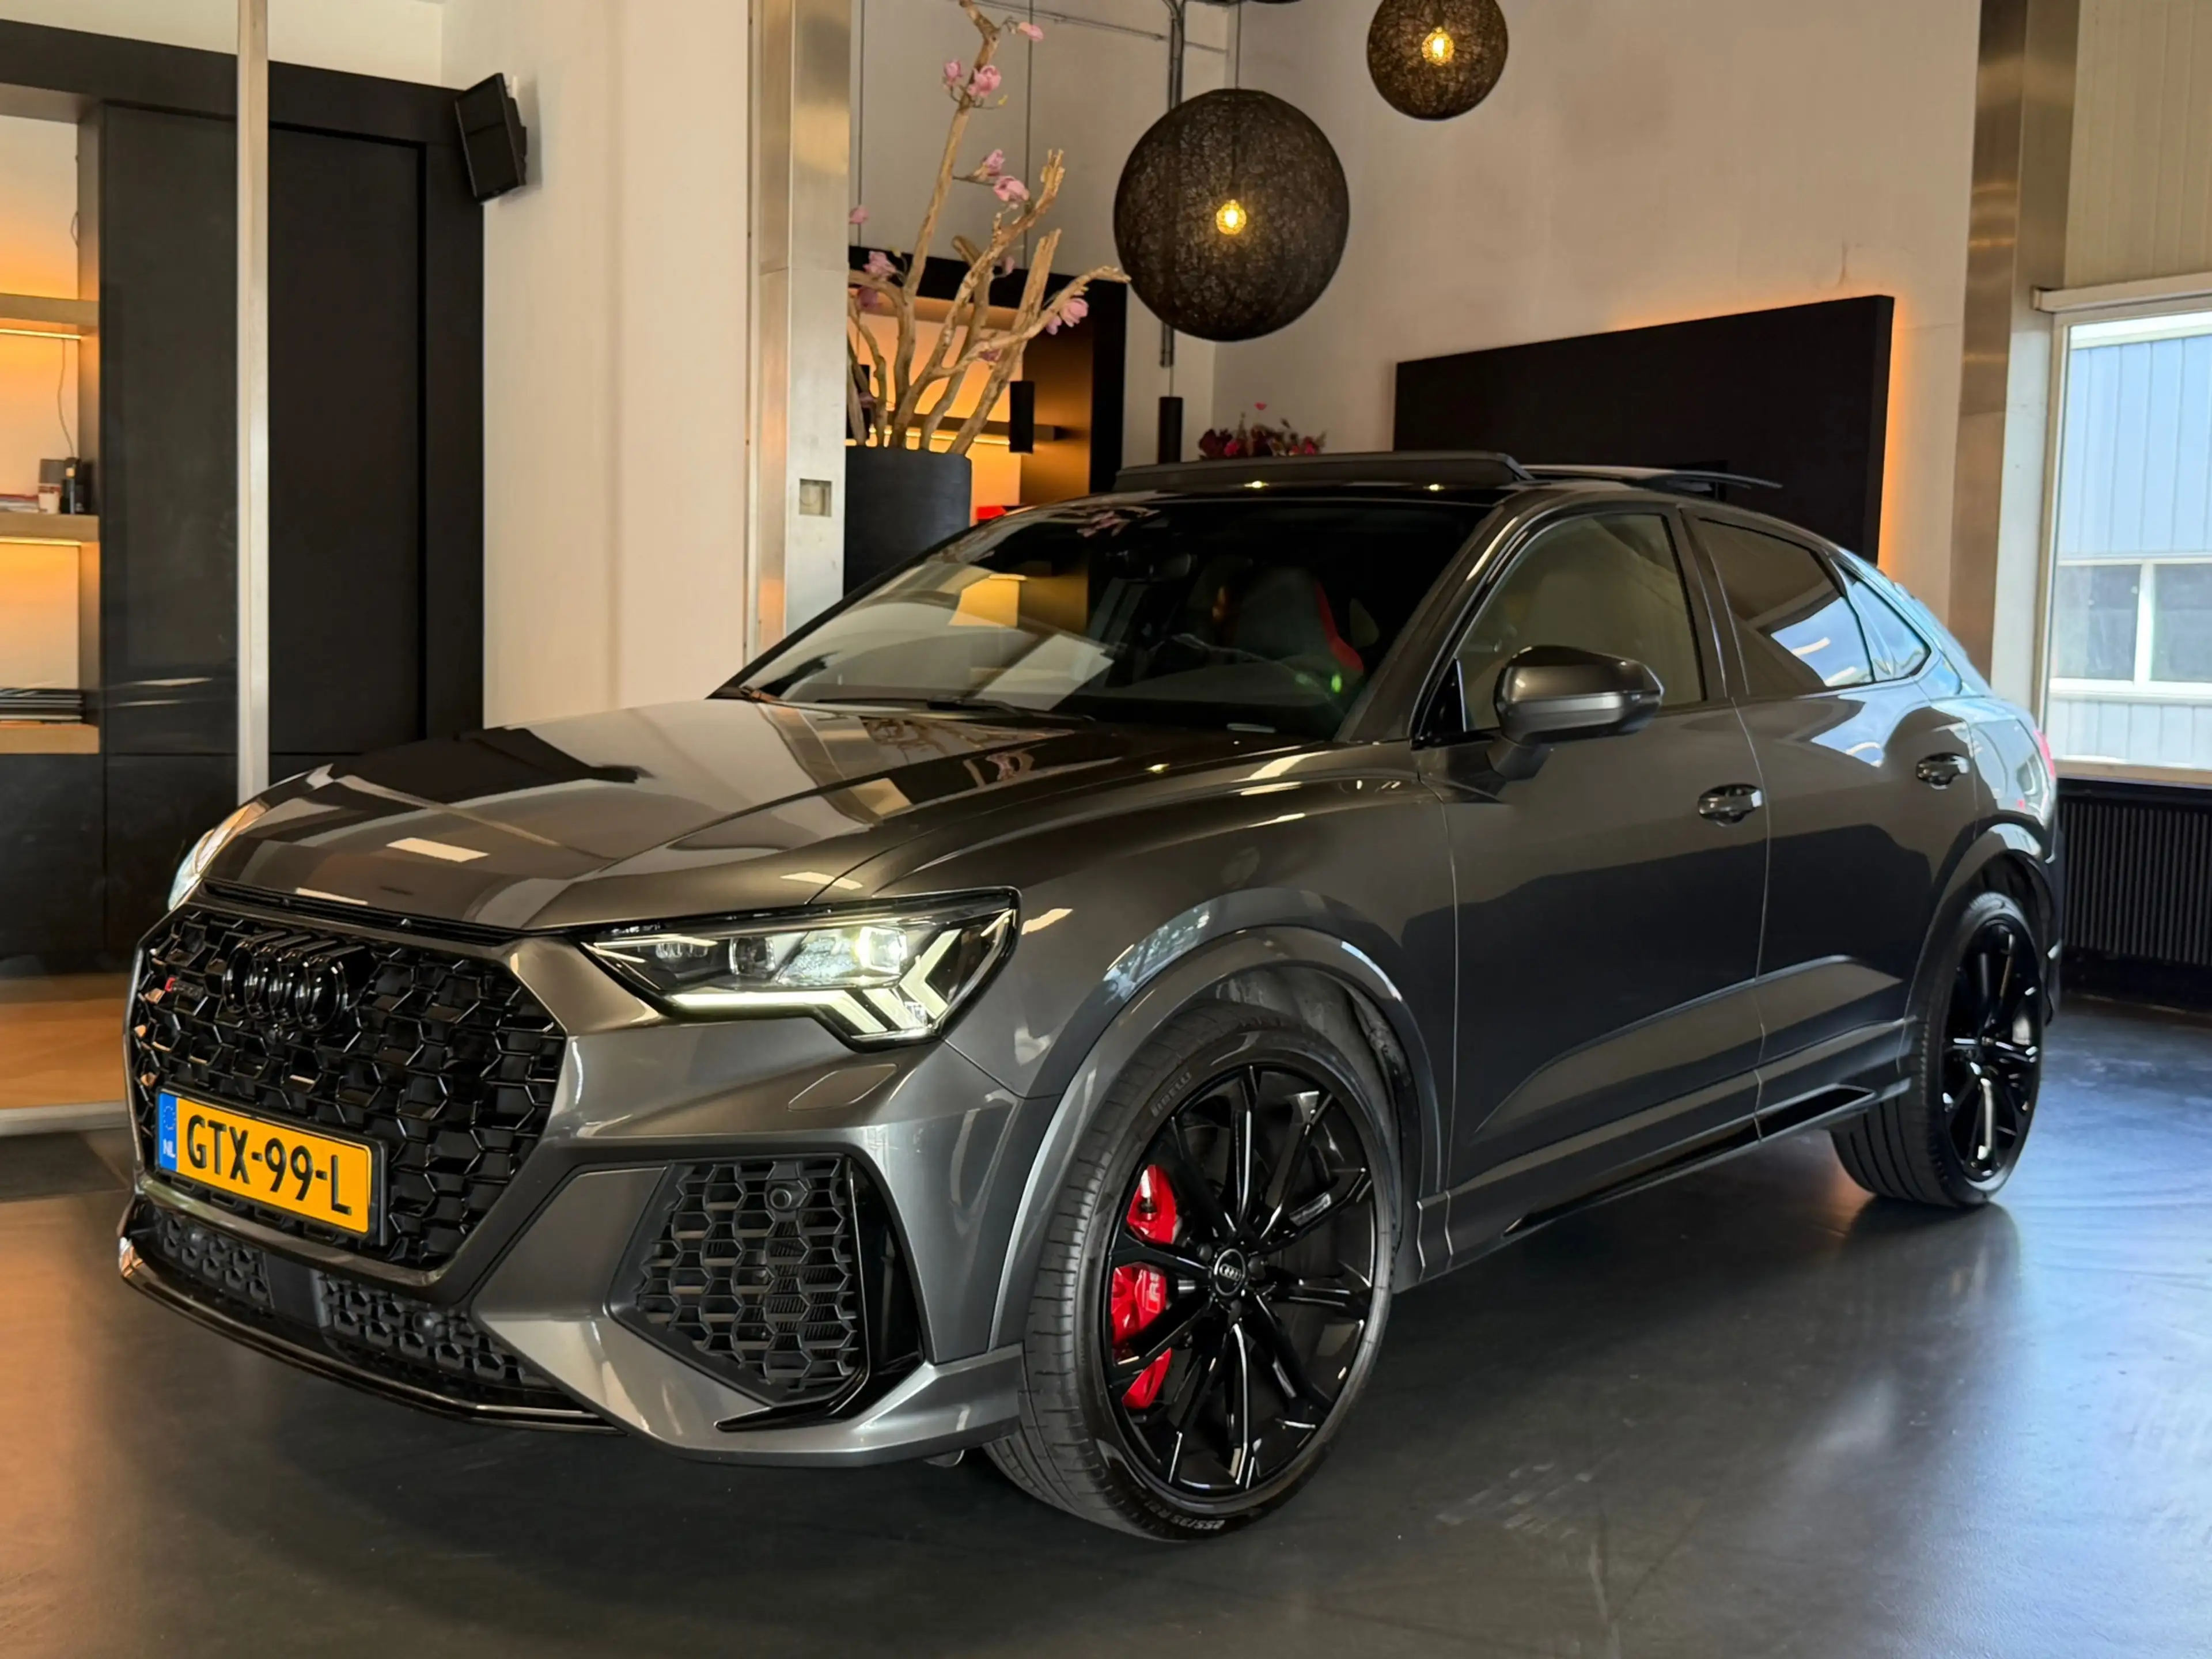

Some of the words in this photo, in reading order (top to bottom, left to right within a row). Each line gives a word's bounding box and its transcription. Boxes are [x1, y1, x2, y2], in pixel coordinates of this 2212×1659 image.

[1150, 1071, 1192, 1117] PIRELLI
[163, 1138, 176, 1158] NL
[187, 1115, 352, 1216] GTX-99-L
